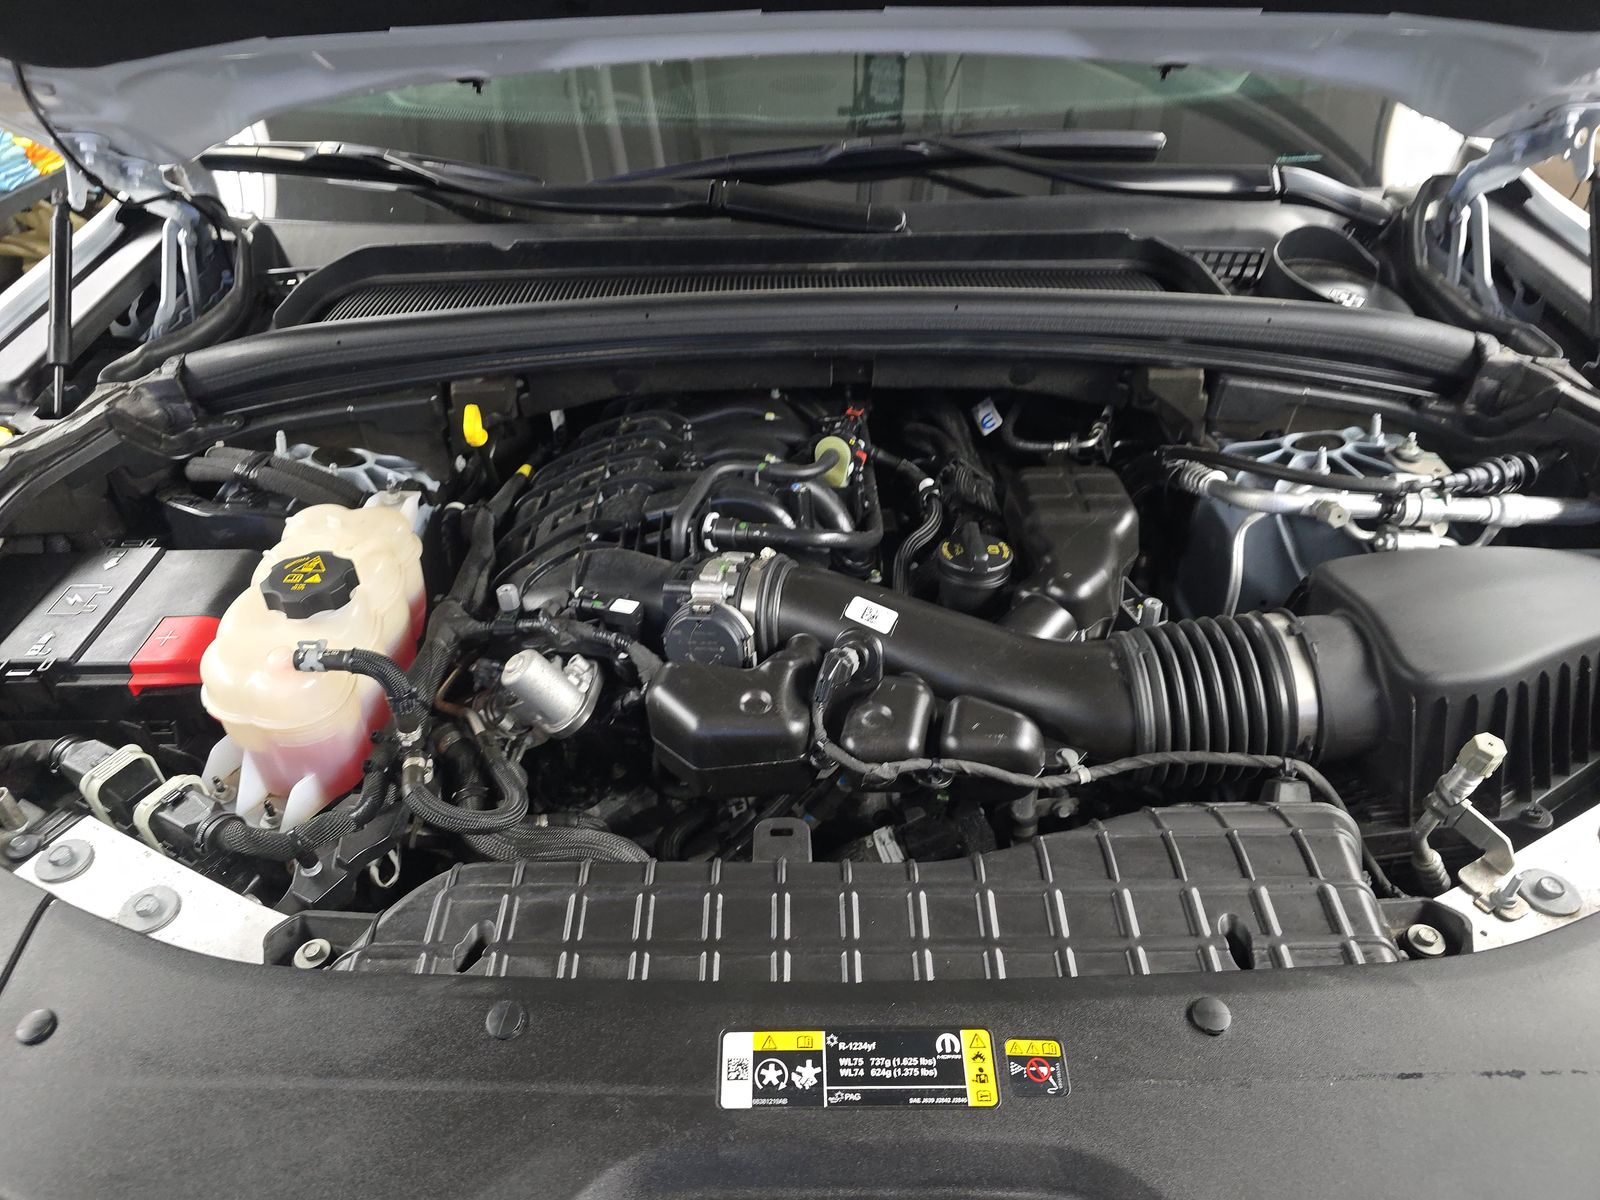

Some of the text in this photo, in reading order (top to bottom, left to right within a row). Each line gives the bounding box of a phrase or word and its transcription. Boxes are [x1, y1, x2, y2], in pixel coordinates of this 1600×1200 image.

[838, 1041, 877, 1052] R-1234yf
[838, 1056, 937, 1068] WL75 737g (1.625 lbs)
[839, 1067, 938, 1079] WL74 624g (1.375 lbs)
[844, 1092, 862, 1101] PAG
